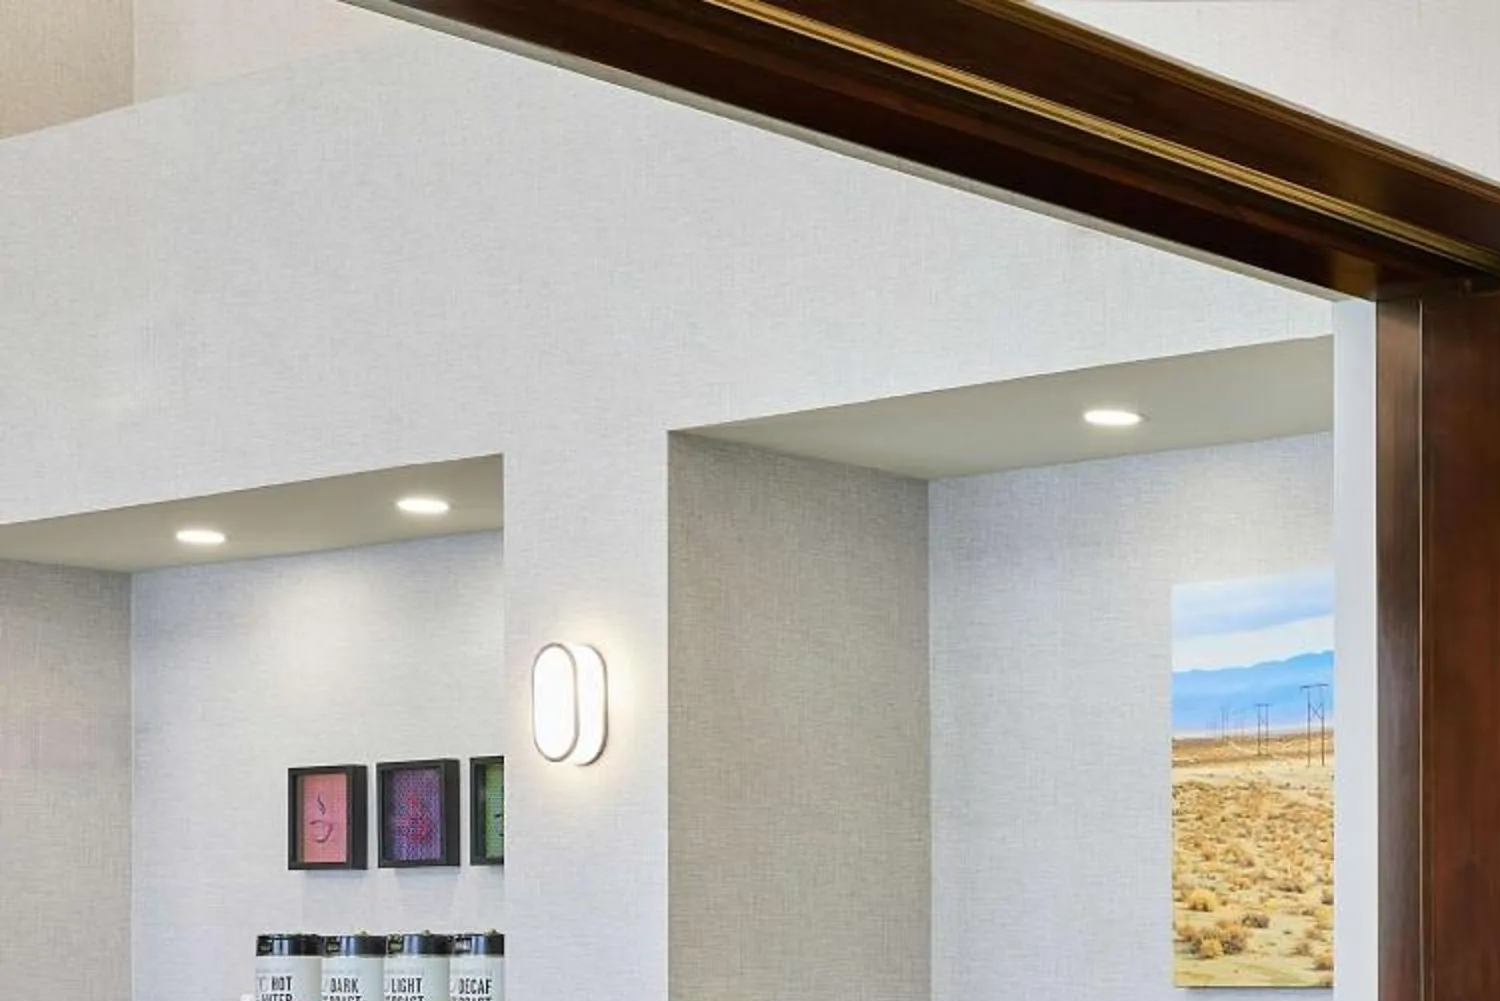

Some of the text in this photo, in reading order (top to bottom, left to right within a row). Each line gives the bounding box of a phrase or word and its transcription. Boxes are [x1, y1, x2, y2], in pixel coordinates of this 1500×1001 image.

[271, 975, 292, 991] HOT
[330, 977, 359, 993] DARK
[391, 977, 423, 993] LIGHT
[458, 978, 493, 994] DECAF
